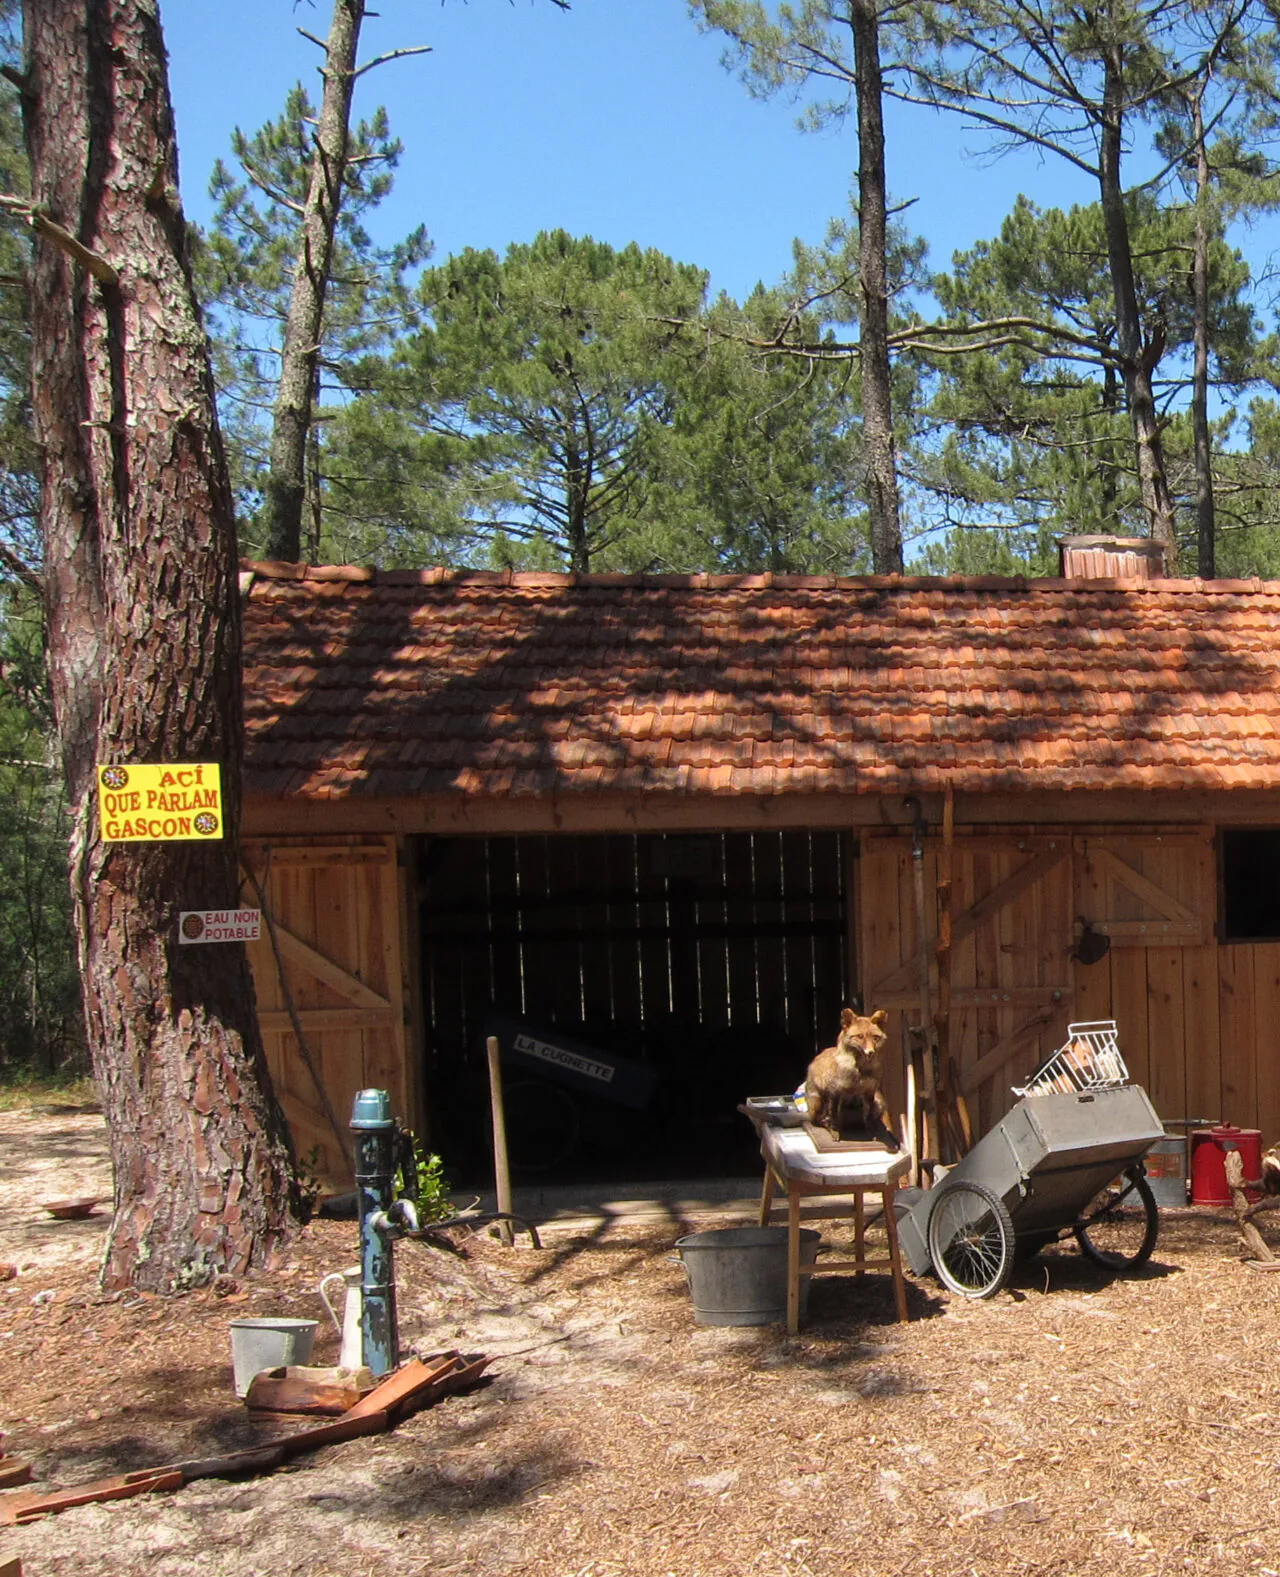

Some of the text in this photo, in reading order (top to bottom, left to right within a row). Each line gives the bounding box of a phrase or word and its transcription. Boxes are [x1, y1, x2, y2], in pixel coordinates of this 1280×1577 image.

[104, 789, 218, 817] QUE PARLAM
[105, 817, 192, 839] GASCON
[205, 910, 260, 925] EAU NON
[205, 926, 259, 940] POTABLE
[517, 1037, 612, 1078] LA CUGNETTE
